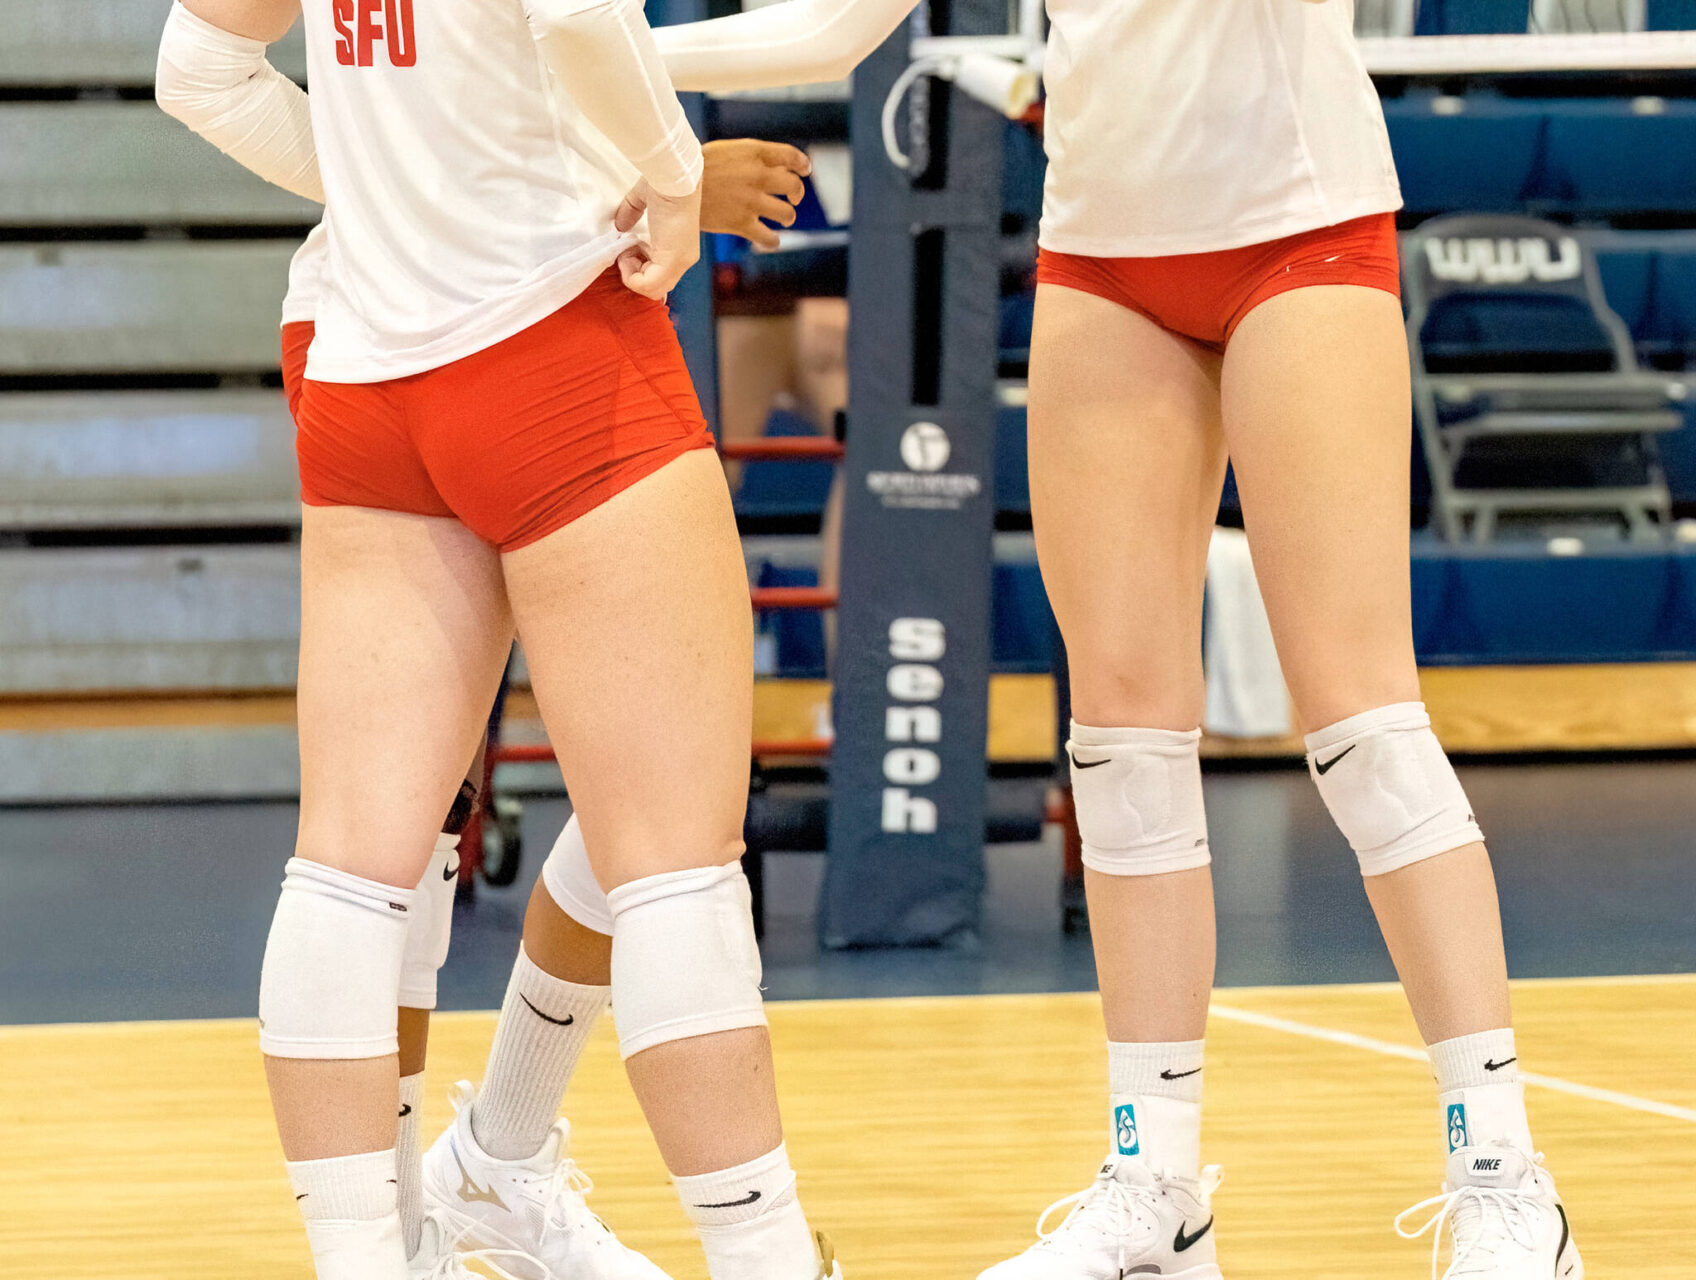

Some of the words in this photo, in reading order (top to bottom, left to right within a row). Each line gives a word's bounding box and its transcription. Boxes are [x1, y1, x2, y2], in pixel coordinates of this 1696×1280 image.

[1425, 236, 1582, 284] WWU
[881, 617, 946, 833] Senoh
[1472, 1158, 1502, 1171] NIKE
